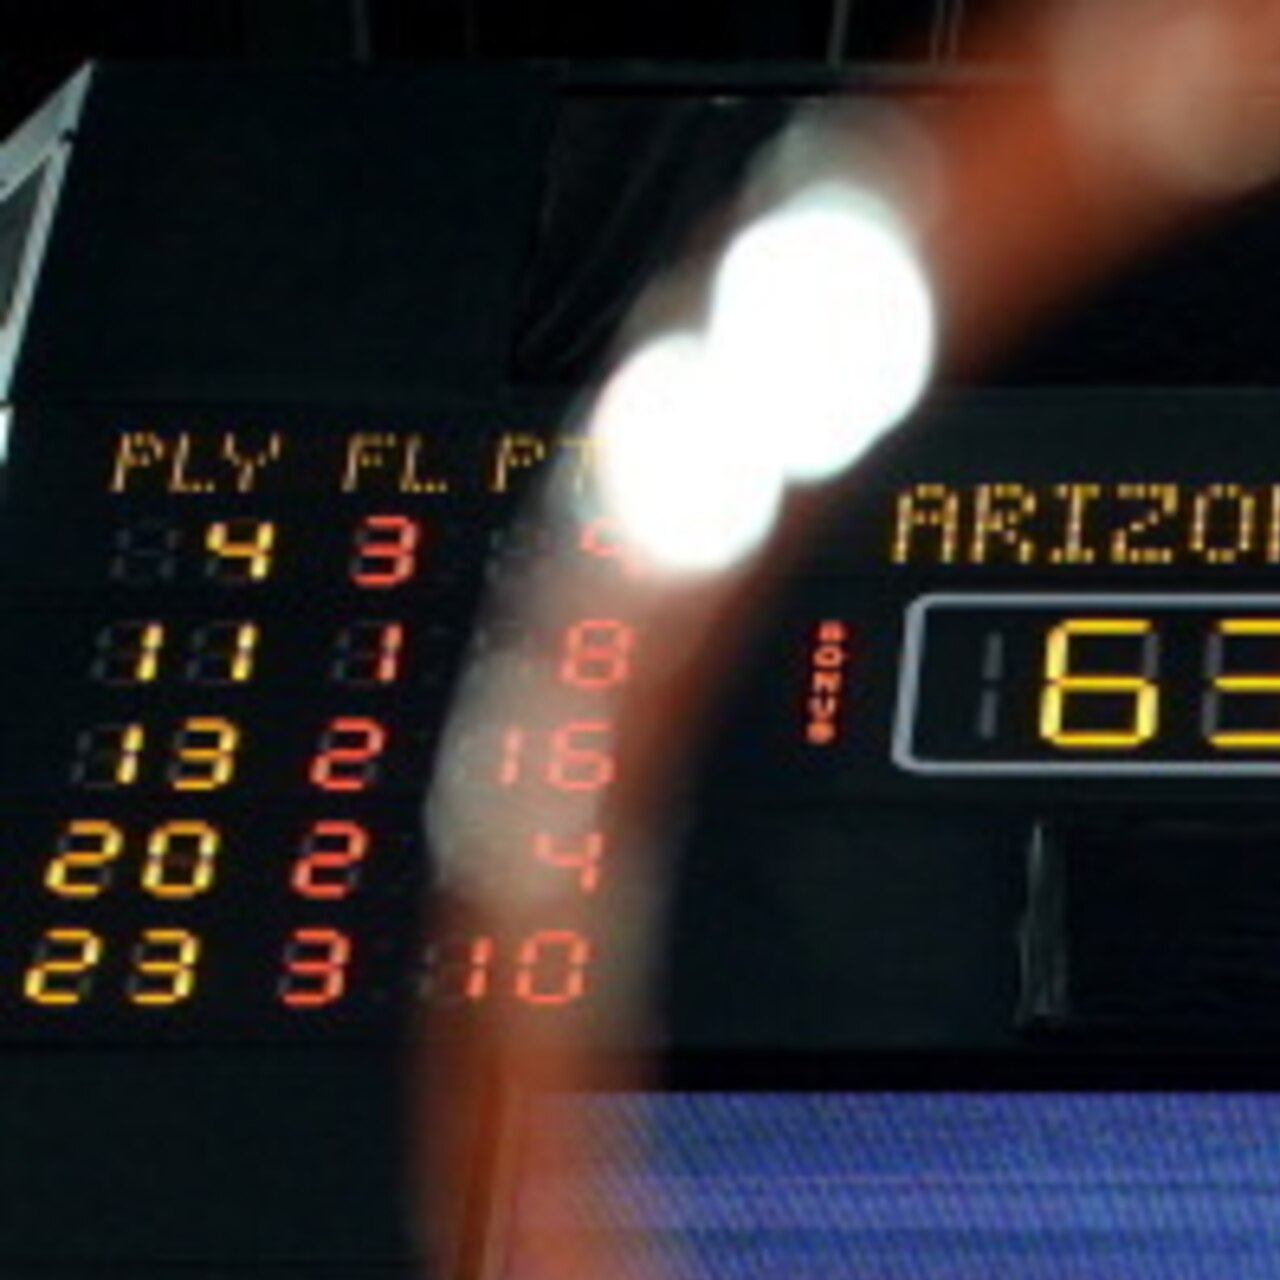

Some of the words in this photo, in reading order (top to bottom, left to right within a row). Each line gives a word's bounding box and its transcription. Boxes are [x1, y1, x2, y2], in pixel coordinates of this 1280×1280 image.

[111, 432, 281, 493] PLY
[342, 433, 447, 494] FL
[491, 432, 624, 493] PT
[206, 521, 275, 582] 4
[352, 514, 418, 586] 3
[136, 622, 258, 683] 11
[378, 622, 402, 683] 1
[558, 618, 636, 689] 8
[116, 717, 241, 792] 13
[310, 717, 385, 792] 2
[500, 720, 616, 791] 16
[45, 821, 219, 897] 20
[292, 821, 368, 897] 2
[536, 830, 607, 892] 4
[23, 929, 199, 1005] 23
[281, 929, 350, 1005] 3
[465, 931, 591, 1005] 10
